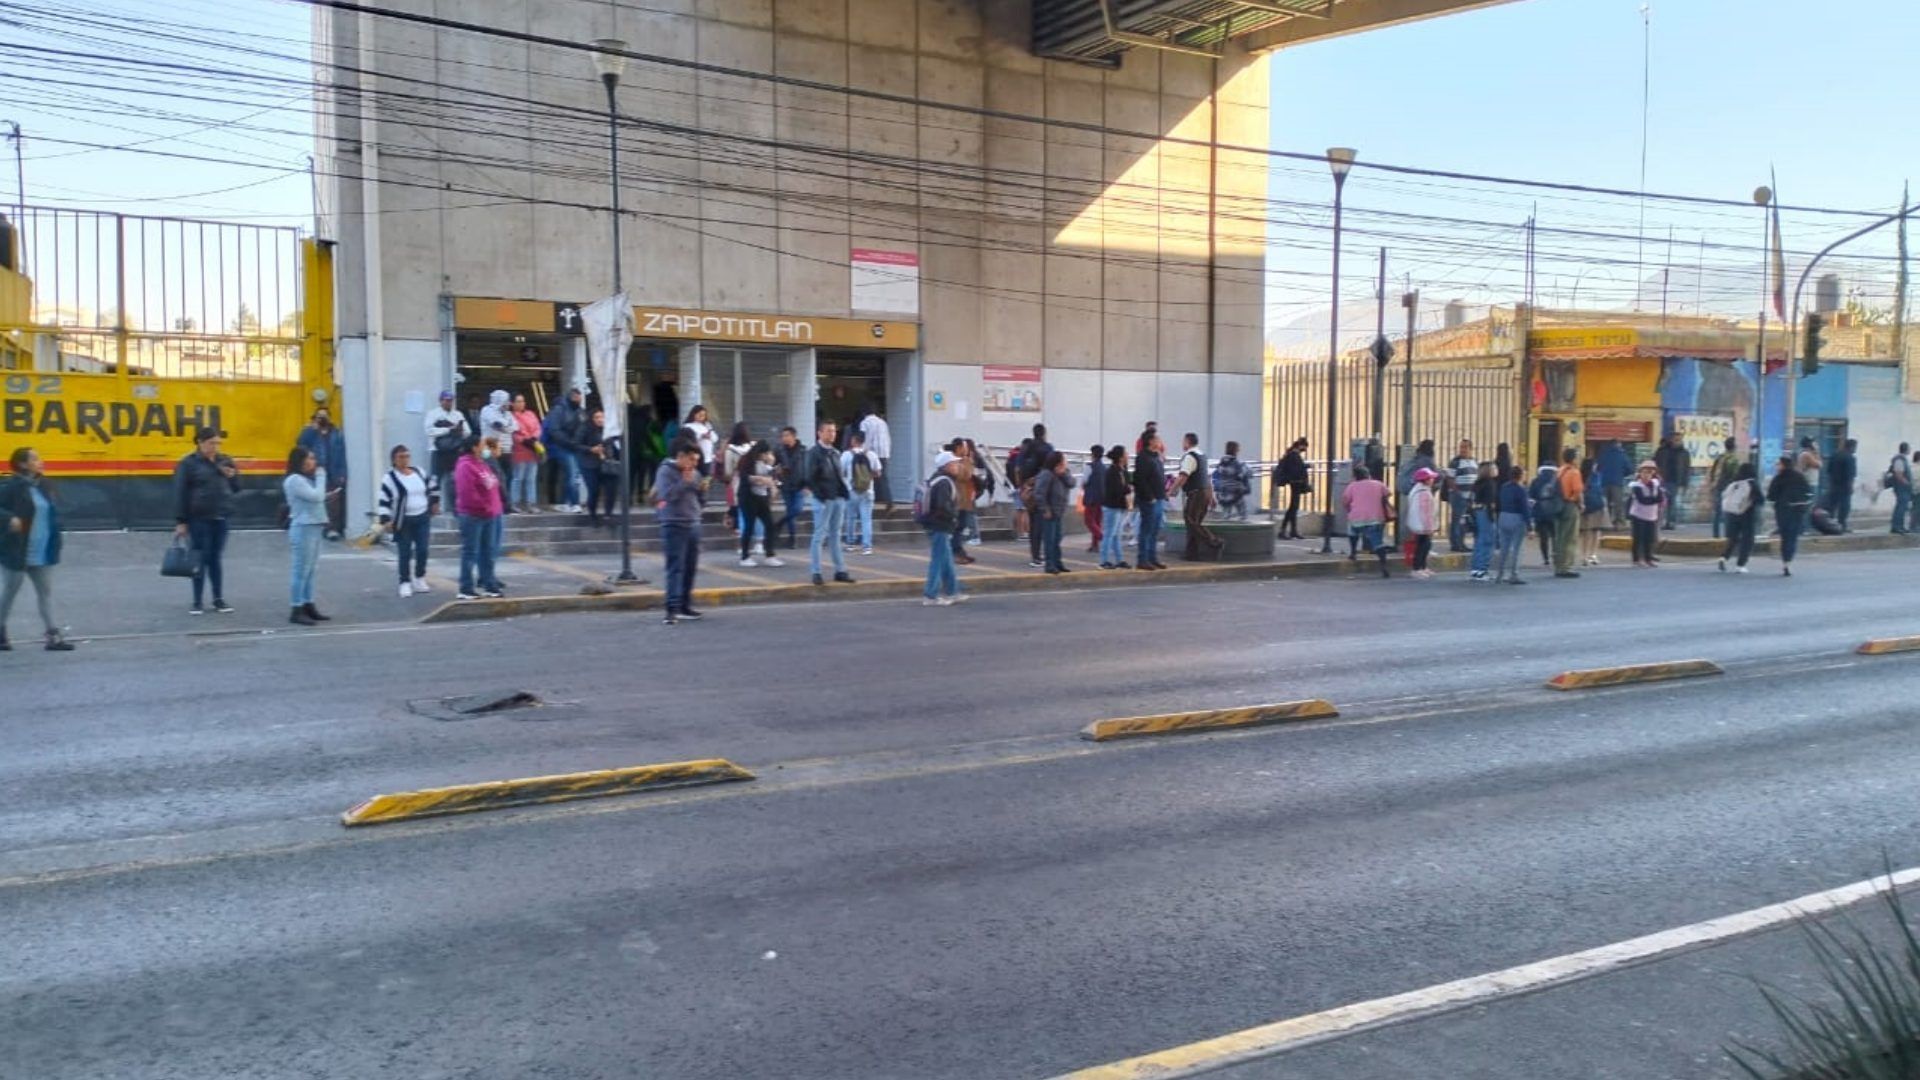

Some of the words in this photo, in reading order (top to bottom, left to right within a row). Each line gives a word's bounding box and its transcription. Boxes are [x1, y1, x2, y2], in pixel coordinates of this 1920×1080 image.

[642, 312, 813, 340] ZAPOTITLAN
[5, 374, 62, 394] 92
[4, 398, 228, 444] BARDAHL
